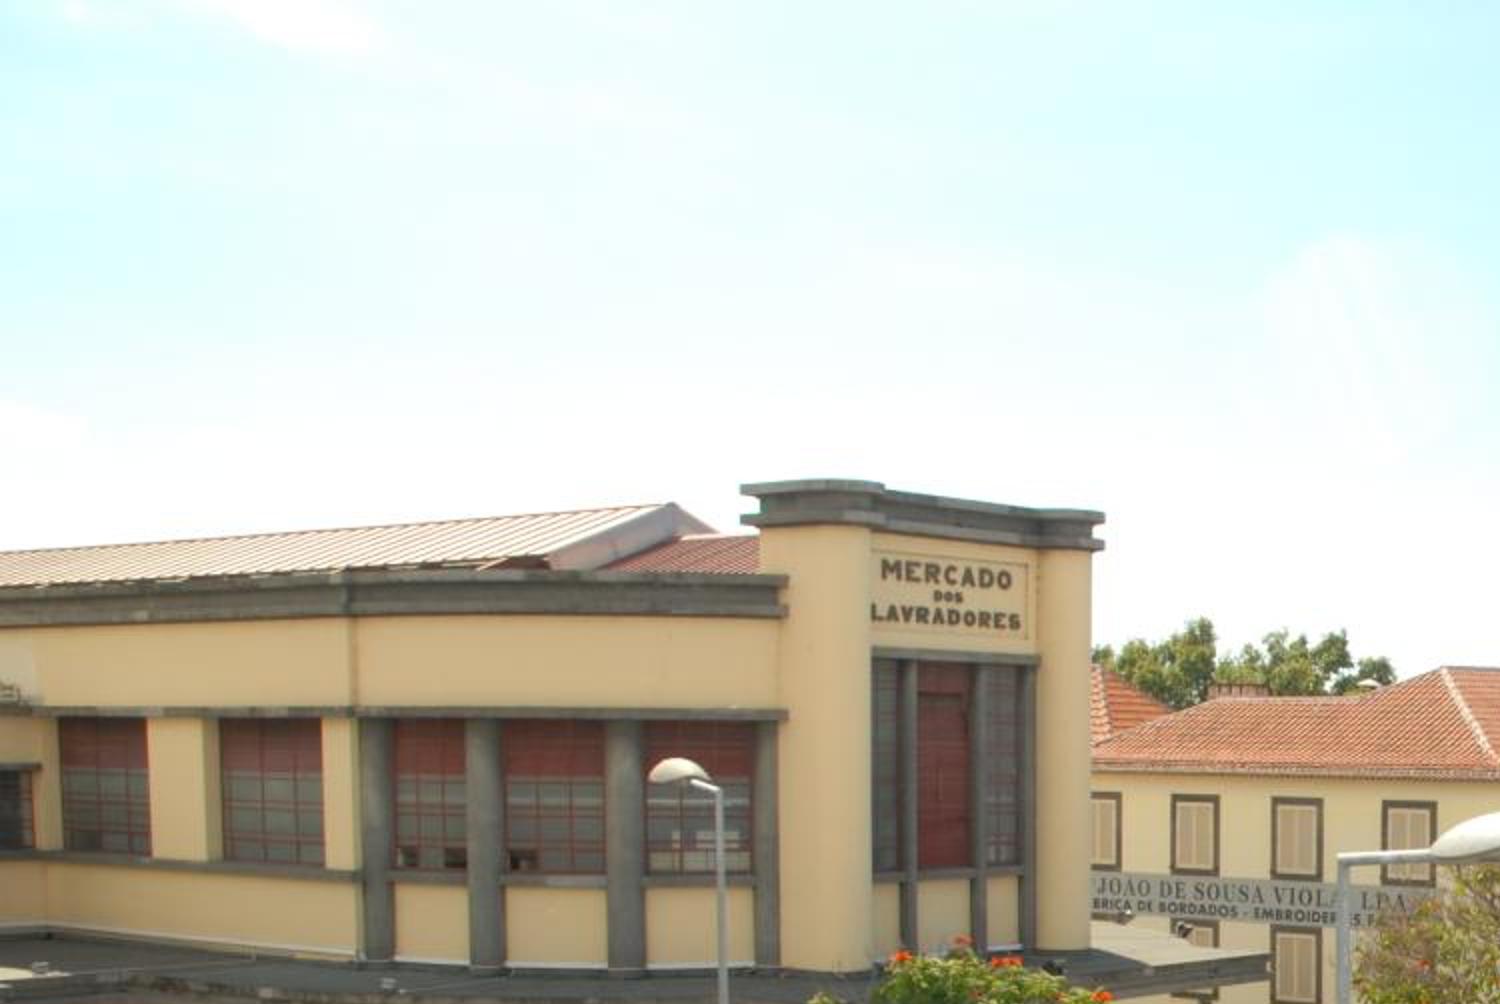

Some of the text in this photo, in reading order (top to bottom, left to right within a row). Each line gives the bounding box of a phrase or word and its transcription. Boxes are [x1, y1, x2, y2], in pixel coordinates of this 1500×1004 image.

[881, 558, 1013, 590] MERCADO
[933, 589, 964, 604] DOS
[870, 603, 1022, 630] LAVRADORES
[1160, 880, 1186, 899] DE
[1194, 882, 1264, 904] SOUSA
[1158, 900, 1238, 918] BORDADOS
